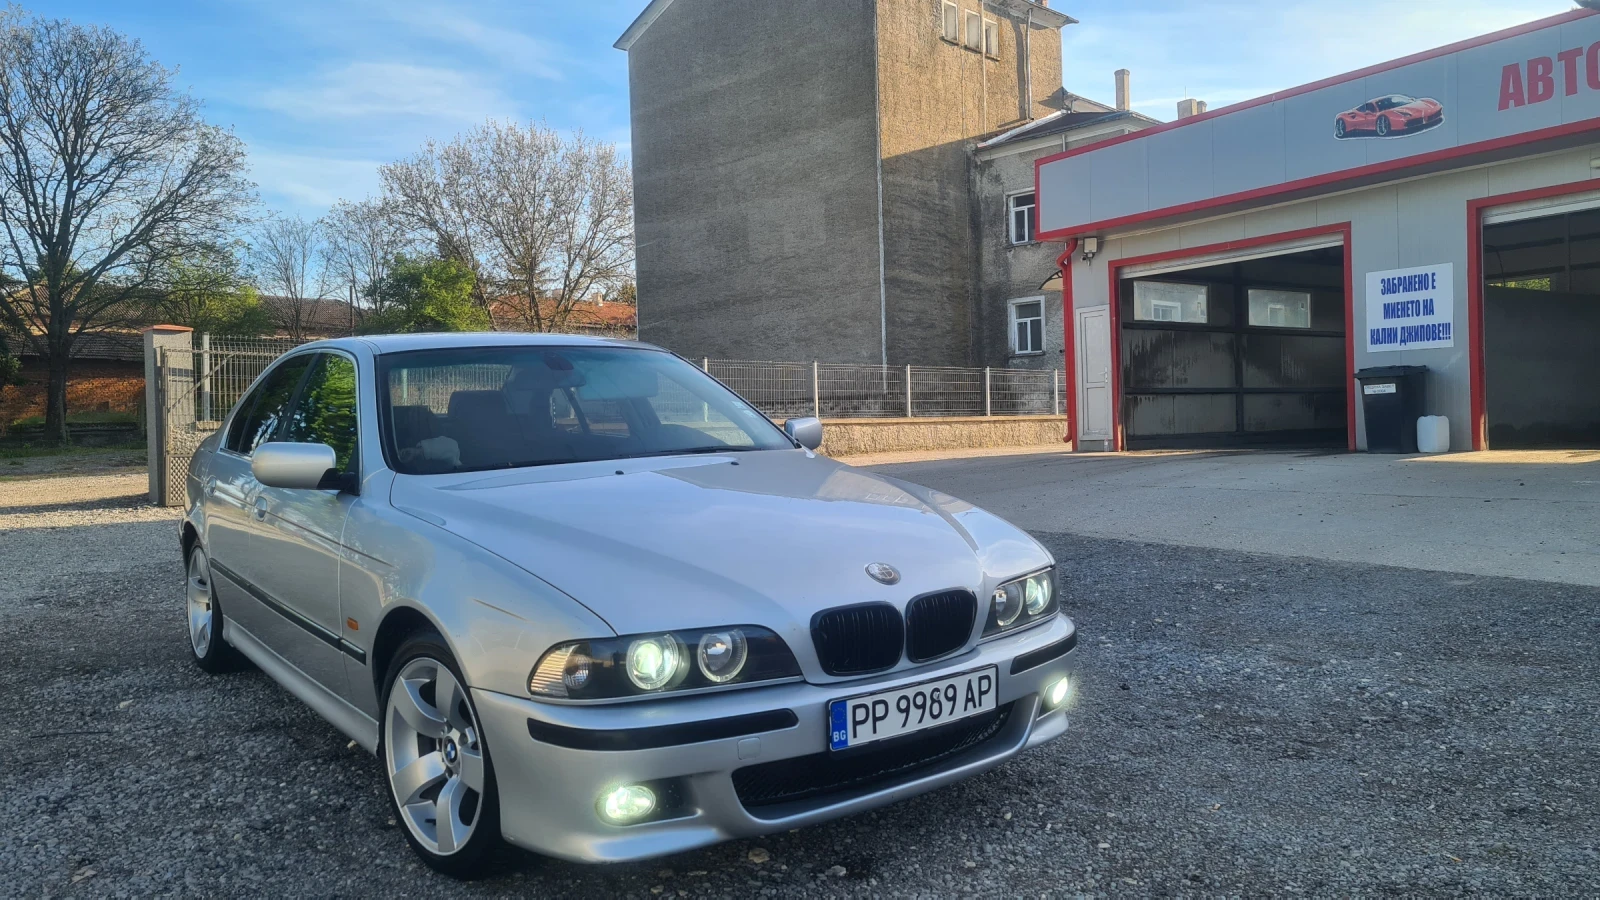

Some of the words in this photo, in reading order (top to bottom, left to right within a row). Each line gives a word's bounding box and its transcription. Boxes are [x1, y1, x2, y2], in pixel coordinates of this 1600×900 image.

[1380, 273, 1430, 296] ЗАБРАНЕНО
[1431, 272, 1437, 290] Е
[1383, 299, 1421, 320] МИЕНЕТО
[1422, 298, 1435, 317] НА
[1370, 326, 1398, 346] КАЛНИ
[1399, 322, 1451, 347] ДЖИПОВЕ!!!
[851, 699, 889, 739] PP
[896, 683, 957, 728] 9989
[963, 674, 992, 712] AP
[832, 729, 847, 742] BG
